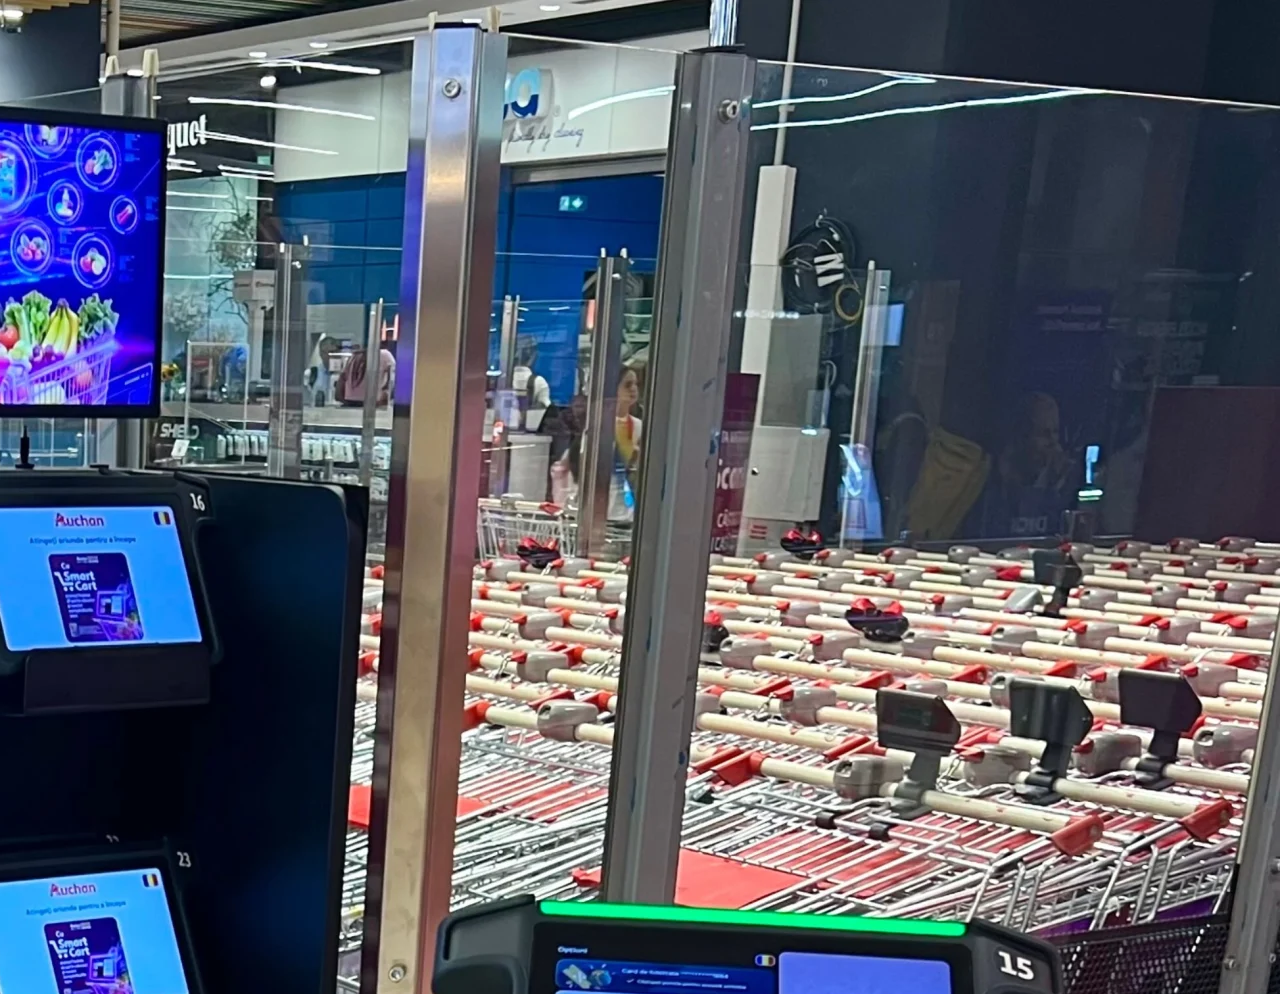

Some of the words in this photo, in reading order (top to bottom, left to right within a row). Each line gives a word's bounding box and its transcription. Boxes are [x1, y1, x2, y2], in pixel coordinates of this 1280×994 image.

[190, 492, 206, 511] 16
[55, 512, 105, 527] Auchan
[63, 571, 96, 582] Smart
[74, 581, 98, 592] Cart
[177, 851, 192, 868] 23
[50, 883, 96, 897] Auchan
[998, 950, 1035, 980] 15
